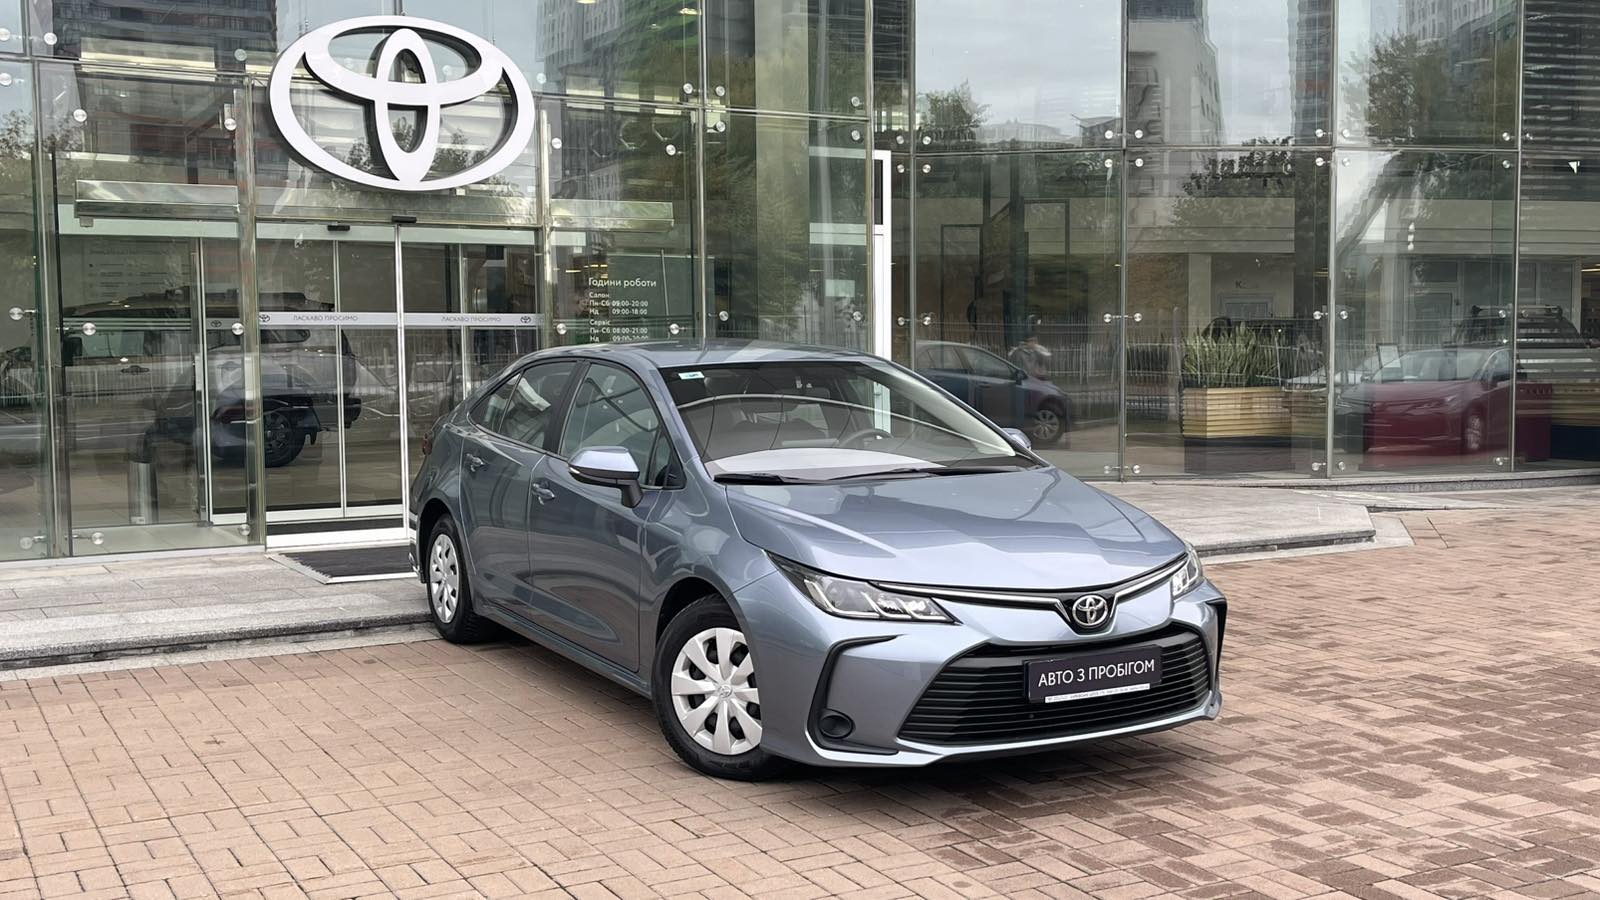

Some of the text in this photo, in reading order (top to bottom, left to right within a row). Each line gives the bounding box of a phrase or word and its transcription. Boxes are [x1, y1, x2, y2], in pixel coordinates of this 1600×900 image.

[588, 277, 657, 288] Години роботи
[589, 291, 610, 299] Салон
[1038, 669, 1074, 687] АВТО
[1088, 659, 1155, 681] ПРОБІГОМ
